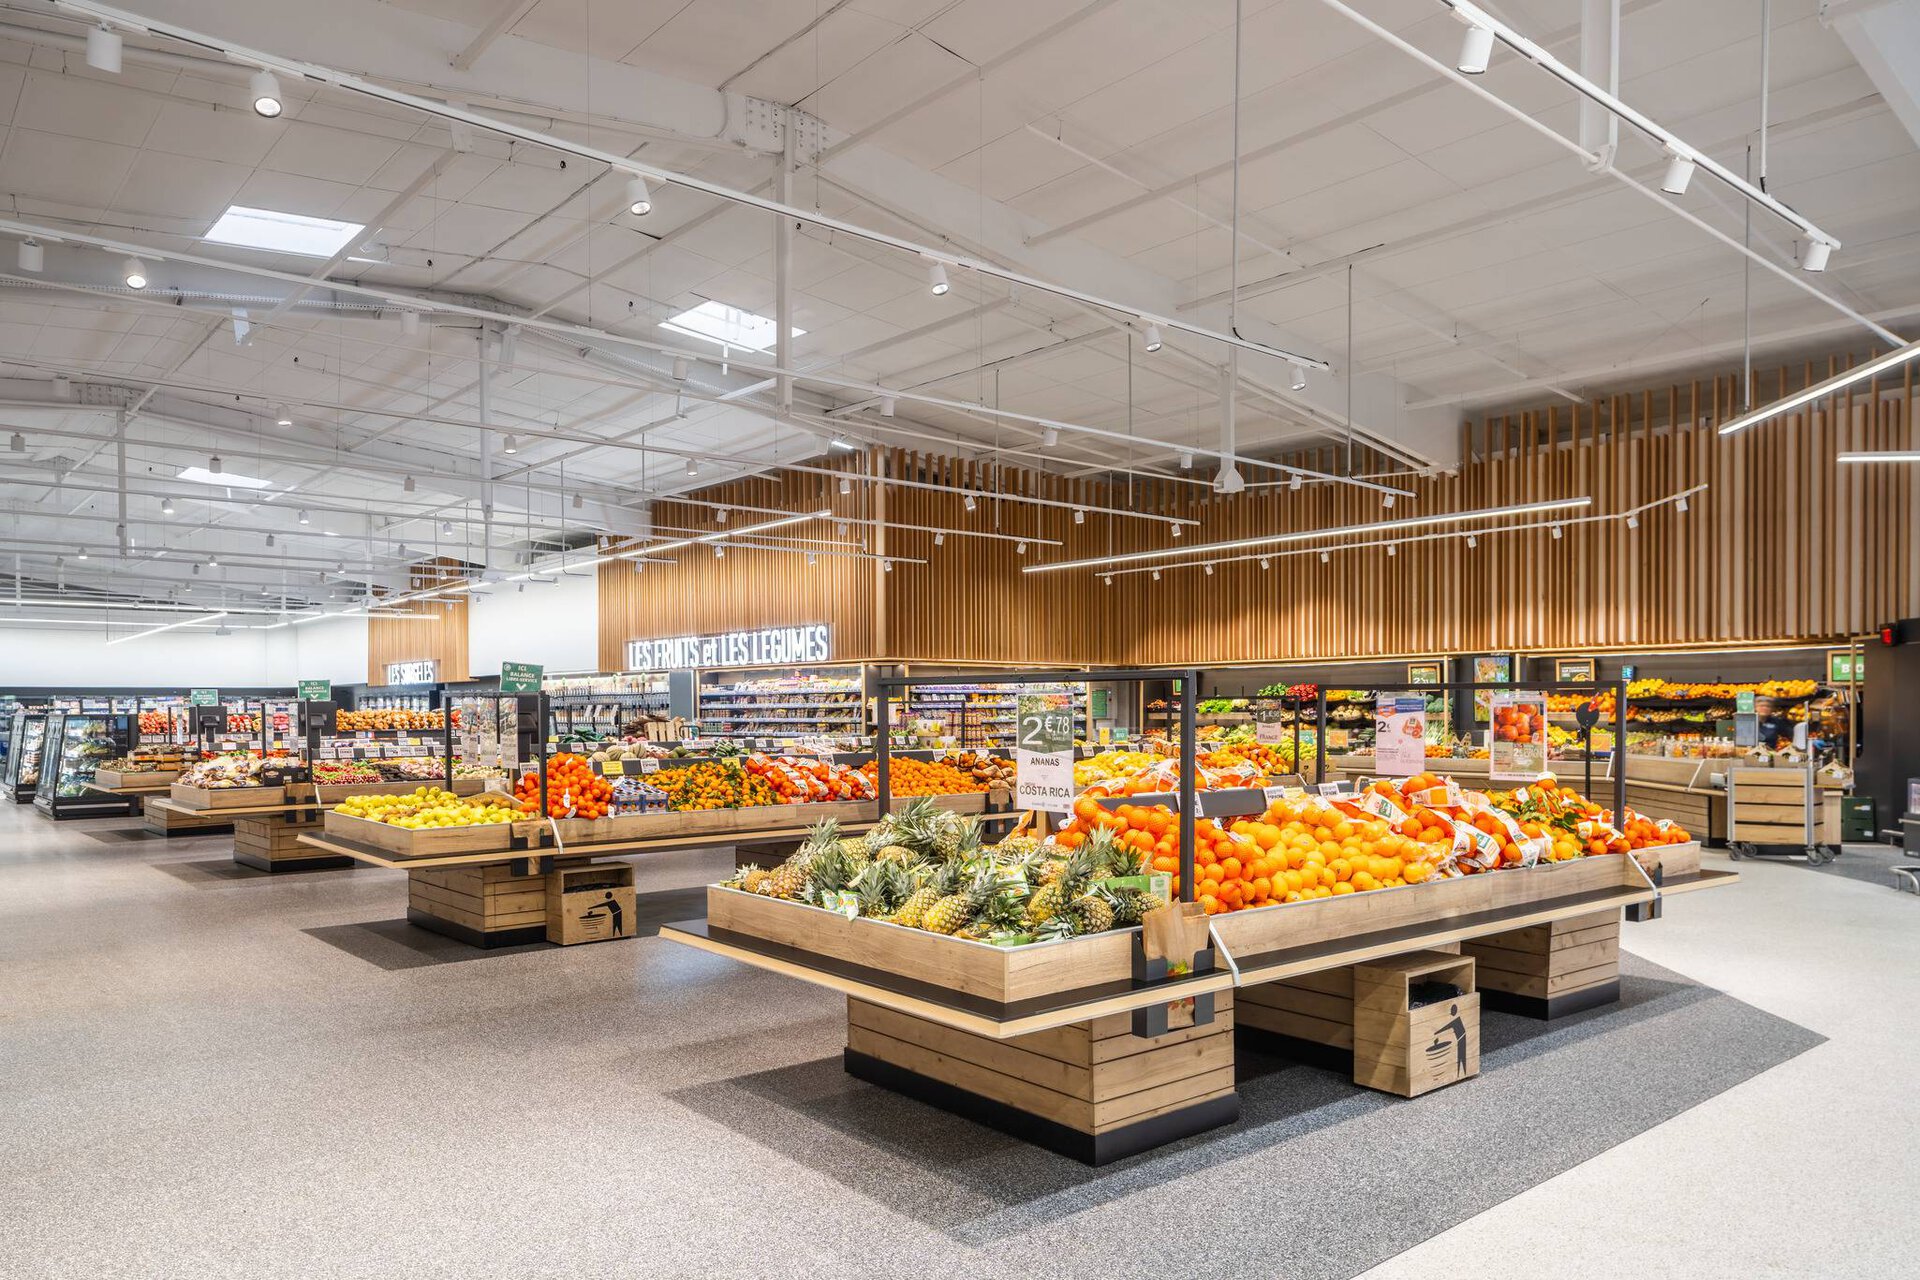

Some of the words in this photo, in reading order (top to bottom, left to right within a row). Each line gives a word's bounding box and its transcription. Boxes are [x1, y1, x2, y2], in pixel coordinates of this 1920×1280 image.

[629, 641, 652, 670] LES
[654, 637, 700, 669] FRUITS
[703, 638, 717, 666] et
[721, 632, 749, 666] LES
[510, 671, 535, 679] BALANCE
[1030, 757, 1060, 767] ANANAS
[1019, 785, 1048, 797] COSTA
[1049, 786, 1071, 798] RICA
